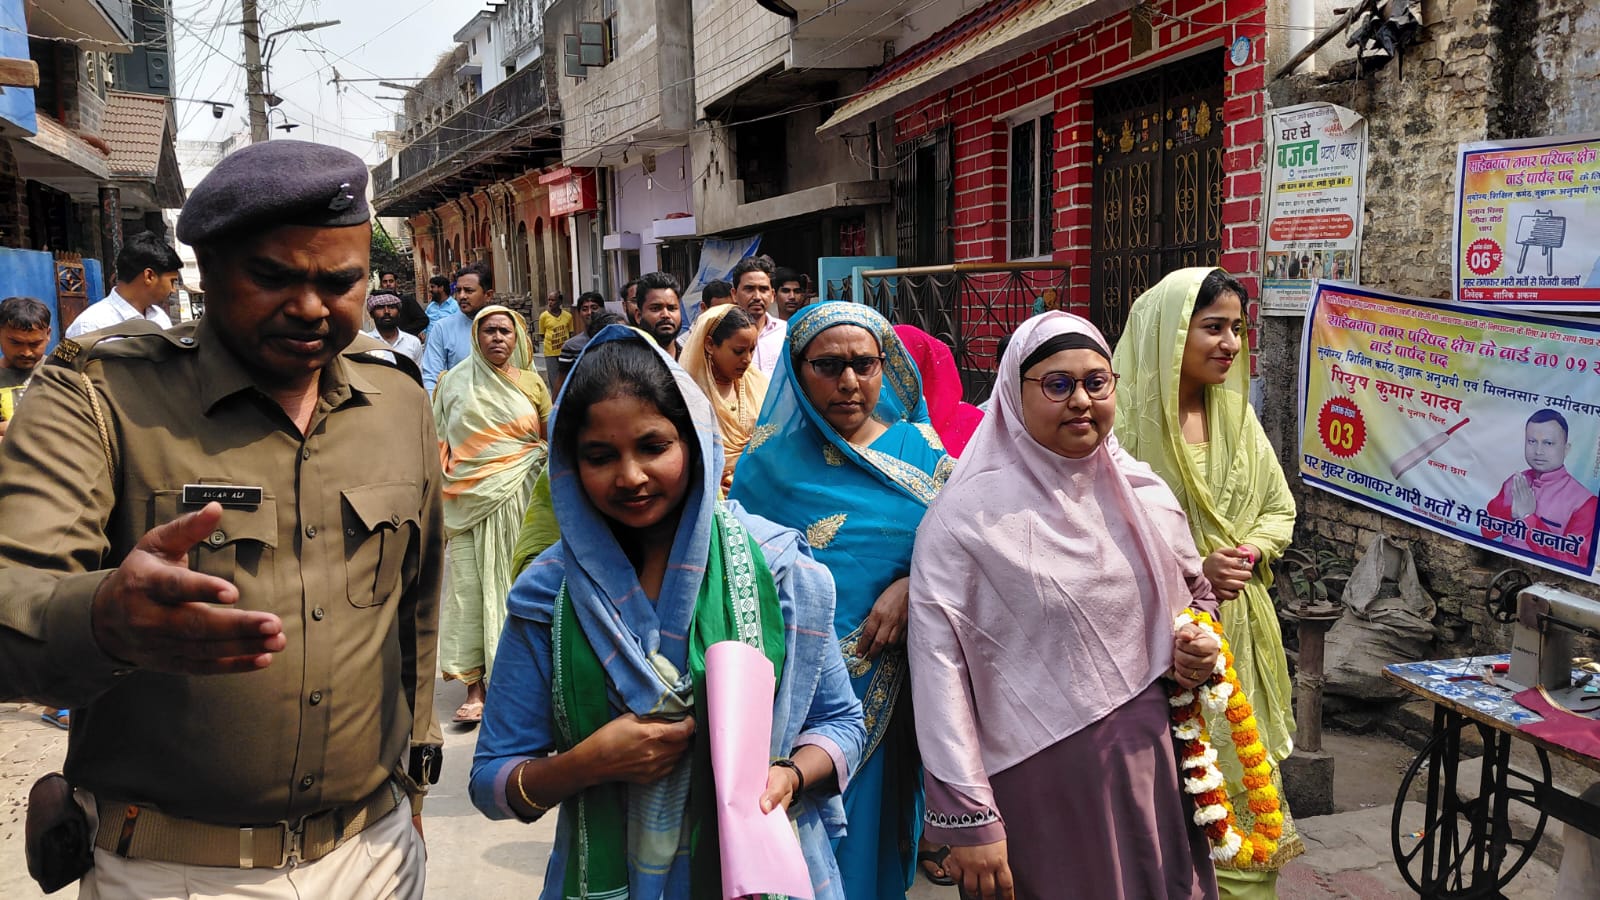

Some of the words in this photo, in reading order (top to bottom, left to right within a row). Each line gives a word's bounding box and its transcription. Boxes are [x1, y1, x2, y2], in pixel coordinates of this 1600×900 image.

[1282, 128, 1297, 141] घर
[1300, 121, 1311, 139] से
[1277, 139, 1320, 168] वजन
[1513, 155, 1537, 169] नगर
[1540, 149, 1575, 166] परिषद
[1577, 147, 1597, 164] क्षेत्र
[1505, 170, 1526, 186] वार्ड
[1527, 168, 1555, 185] पार्षद
[1558, 169, 1575, 182] पद
[1591, 170, 1600, 180] लि
[1471, 251, 1491, 269] 06
[1500, 276, 1514, 286] भारी
[1516, 276, 1530, 286] मतों
[1530, 276, 1537, 286] से
[1538, 276, 1560, 287] विजयी
[1327, 313, 1376, 335] साहेबगंज
[1378, 324, 1405, 340] नगर
[1408, 326, 1448, 349] परिषद
[1450, 335, 1475, 355] क्षेत्र
[1478, 340, 1496, 358] के
[1498, 346, 1532, 363] वार्ड
[1370, 339, 1394, 355] वार्ड
[1395, 344, 1426, 363] पार्षद
[1429, 352, 1449, 368] पद
[1330, 364, 1370, 394] पियुष
[1376, 378, 1414, 402] कुमार
[1420, 388, 1463, 414] यादव
[1397, 365, 1424, 380] जुझारू
[1426, 370, 1459, 389] अनुभवी
[1463, 378, 1481, 394] एवं
[1483, 380, 1540, 404] मिलनसार
[1407, 408, 1426, 420] चुनाव
[1330, 419, 1354, 450] 03
[1428, 458, 1448, 471] बल्ला
[1450, 464, 1468, 477] छाप
[1304, 454, 1320, 470] पर
[1320, 459, 1346, 479] मुहर
[1346, 468, 1394, 496] लगाकर
[1395, 486, 1422, 507] भारी
[1424, 495, 1455, 518] मतों
[1456, 504, 1473, 524] से
[1476, 509, 1528, 541] विजयी
[1532, 528, 1584, 556] बनावें
